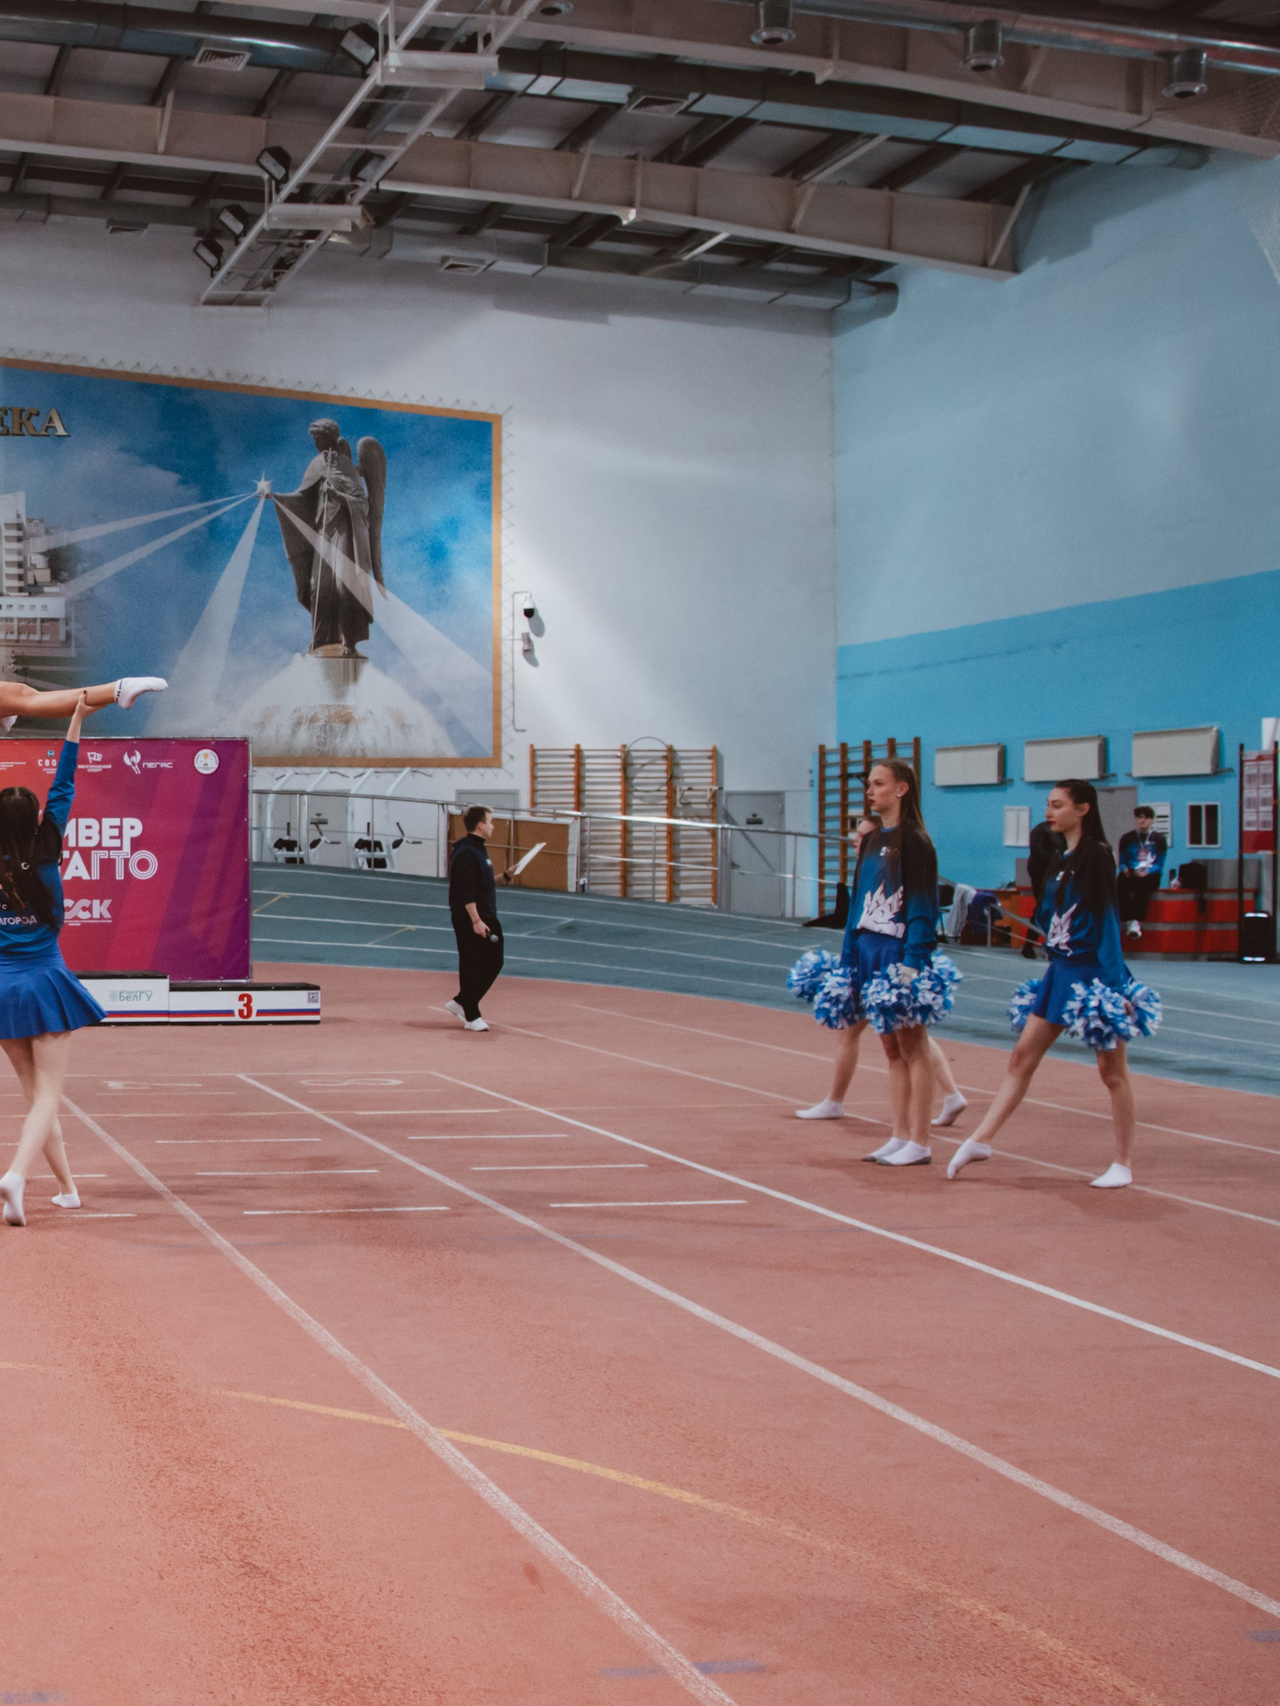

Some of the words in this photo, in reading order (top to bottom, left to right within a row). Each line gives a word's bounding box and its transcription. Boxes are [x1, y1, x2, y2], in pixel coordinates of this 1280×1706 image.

[63, 817, 143, 858] ИВЕР
[63, 898, 113, 920] ССК
[118, 990, 153, 1002] БелГУ
[237, 993, 253, 1019] 3
